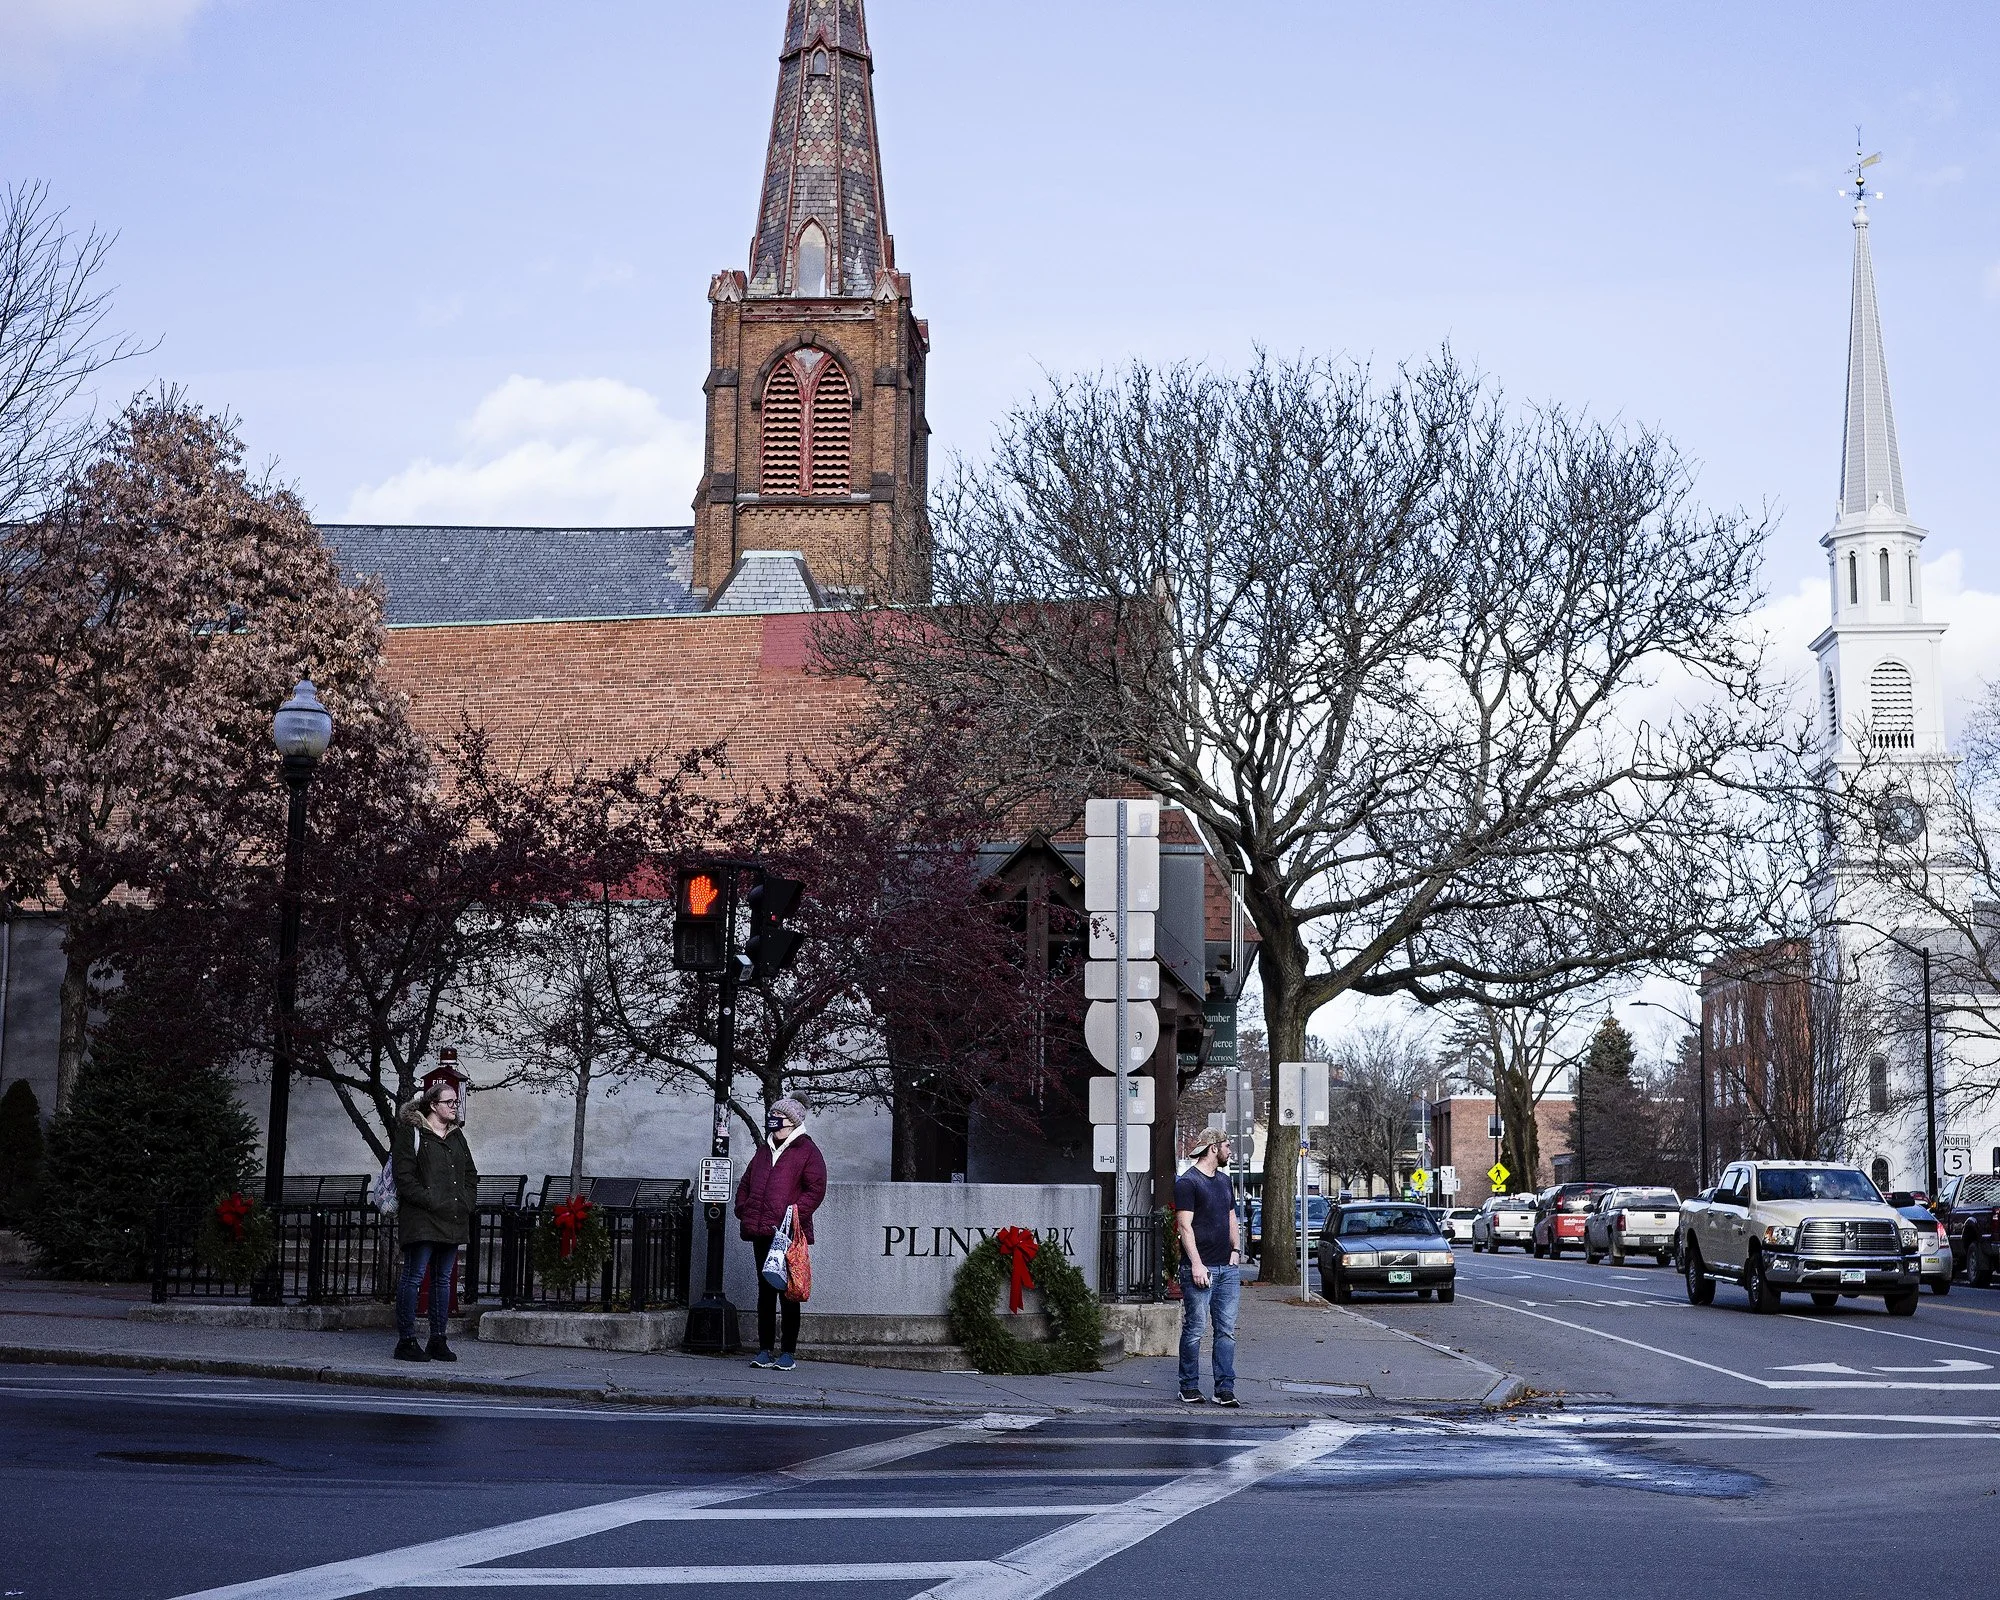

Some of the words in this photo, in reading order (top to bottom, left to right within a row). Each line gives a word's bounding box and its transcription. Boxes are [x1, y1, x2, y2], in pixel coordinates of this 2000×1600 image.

[1202, 1011, 1230, 1022] amber
[1212, 1040, 1233, 1048] merce
[1944, 1135, 1969, 1146] NORTH
[1952, 1154, 1963, 1170] 5
[1018, 1226, 1075, 1257] RK
